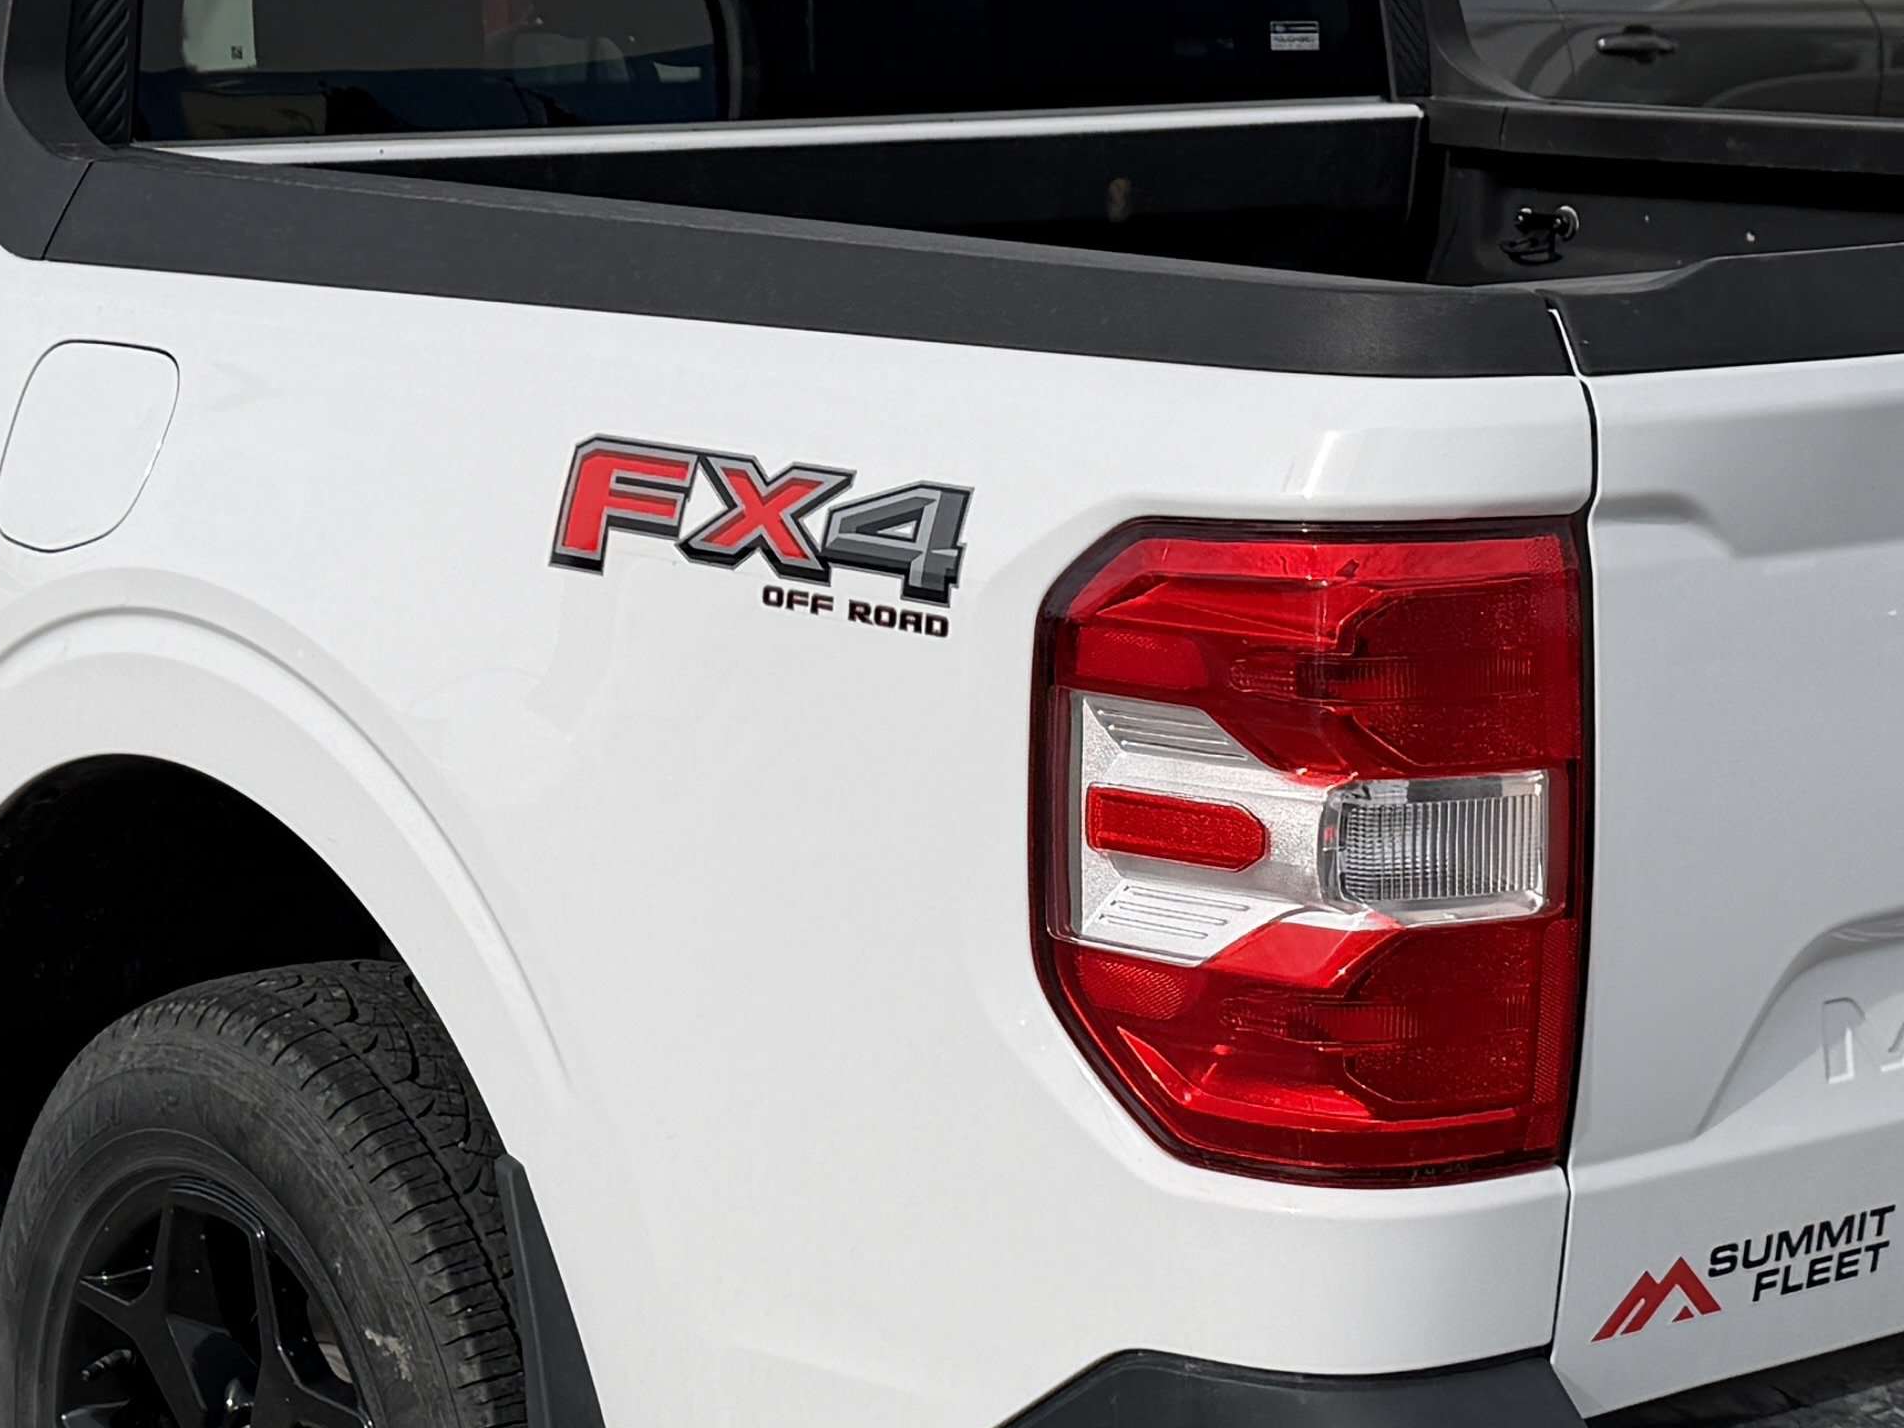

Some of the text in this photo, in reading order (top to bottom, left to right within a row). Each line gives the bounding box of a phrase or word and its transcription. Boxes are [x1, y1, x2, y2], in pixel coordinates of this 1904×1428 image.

[548, 433, 975, 608] FX4
[761, 584, 950, 638] OFF ROAD
[1707, 1204, 1896, 1278] SUMMIT
[1751, 1240, 1891, 1303] FLEET
